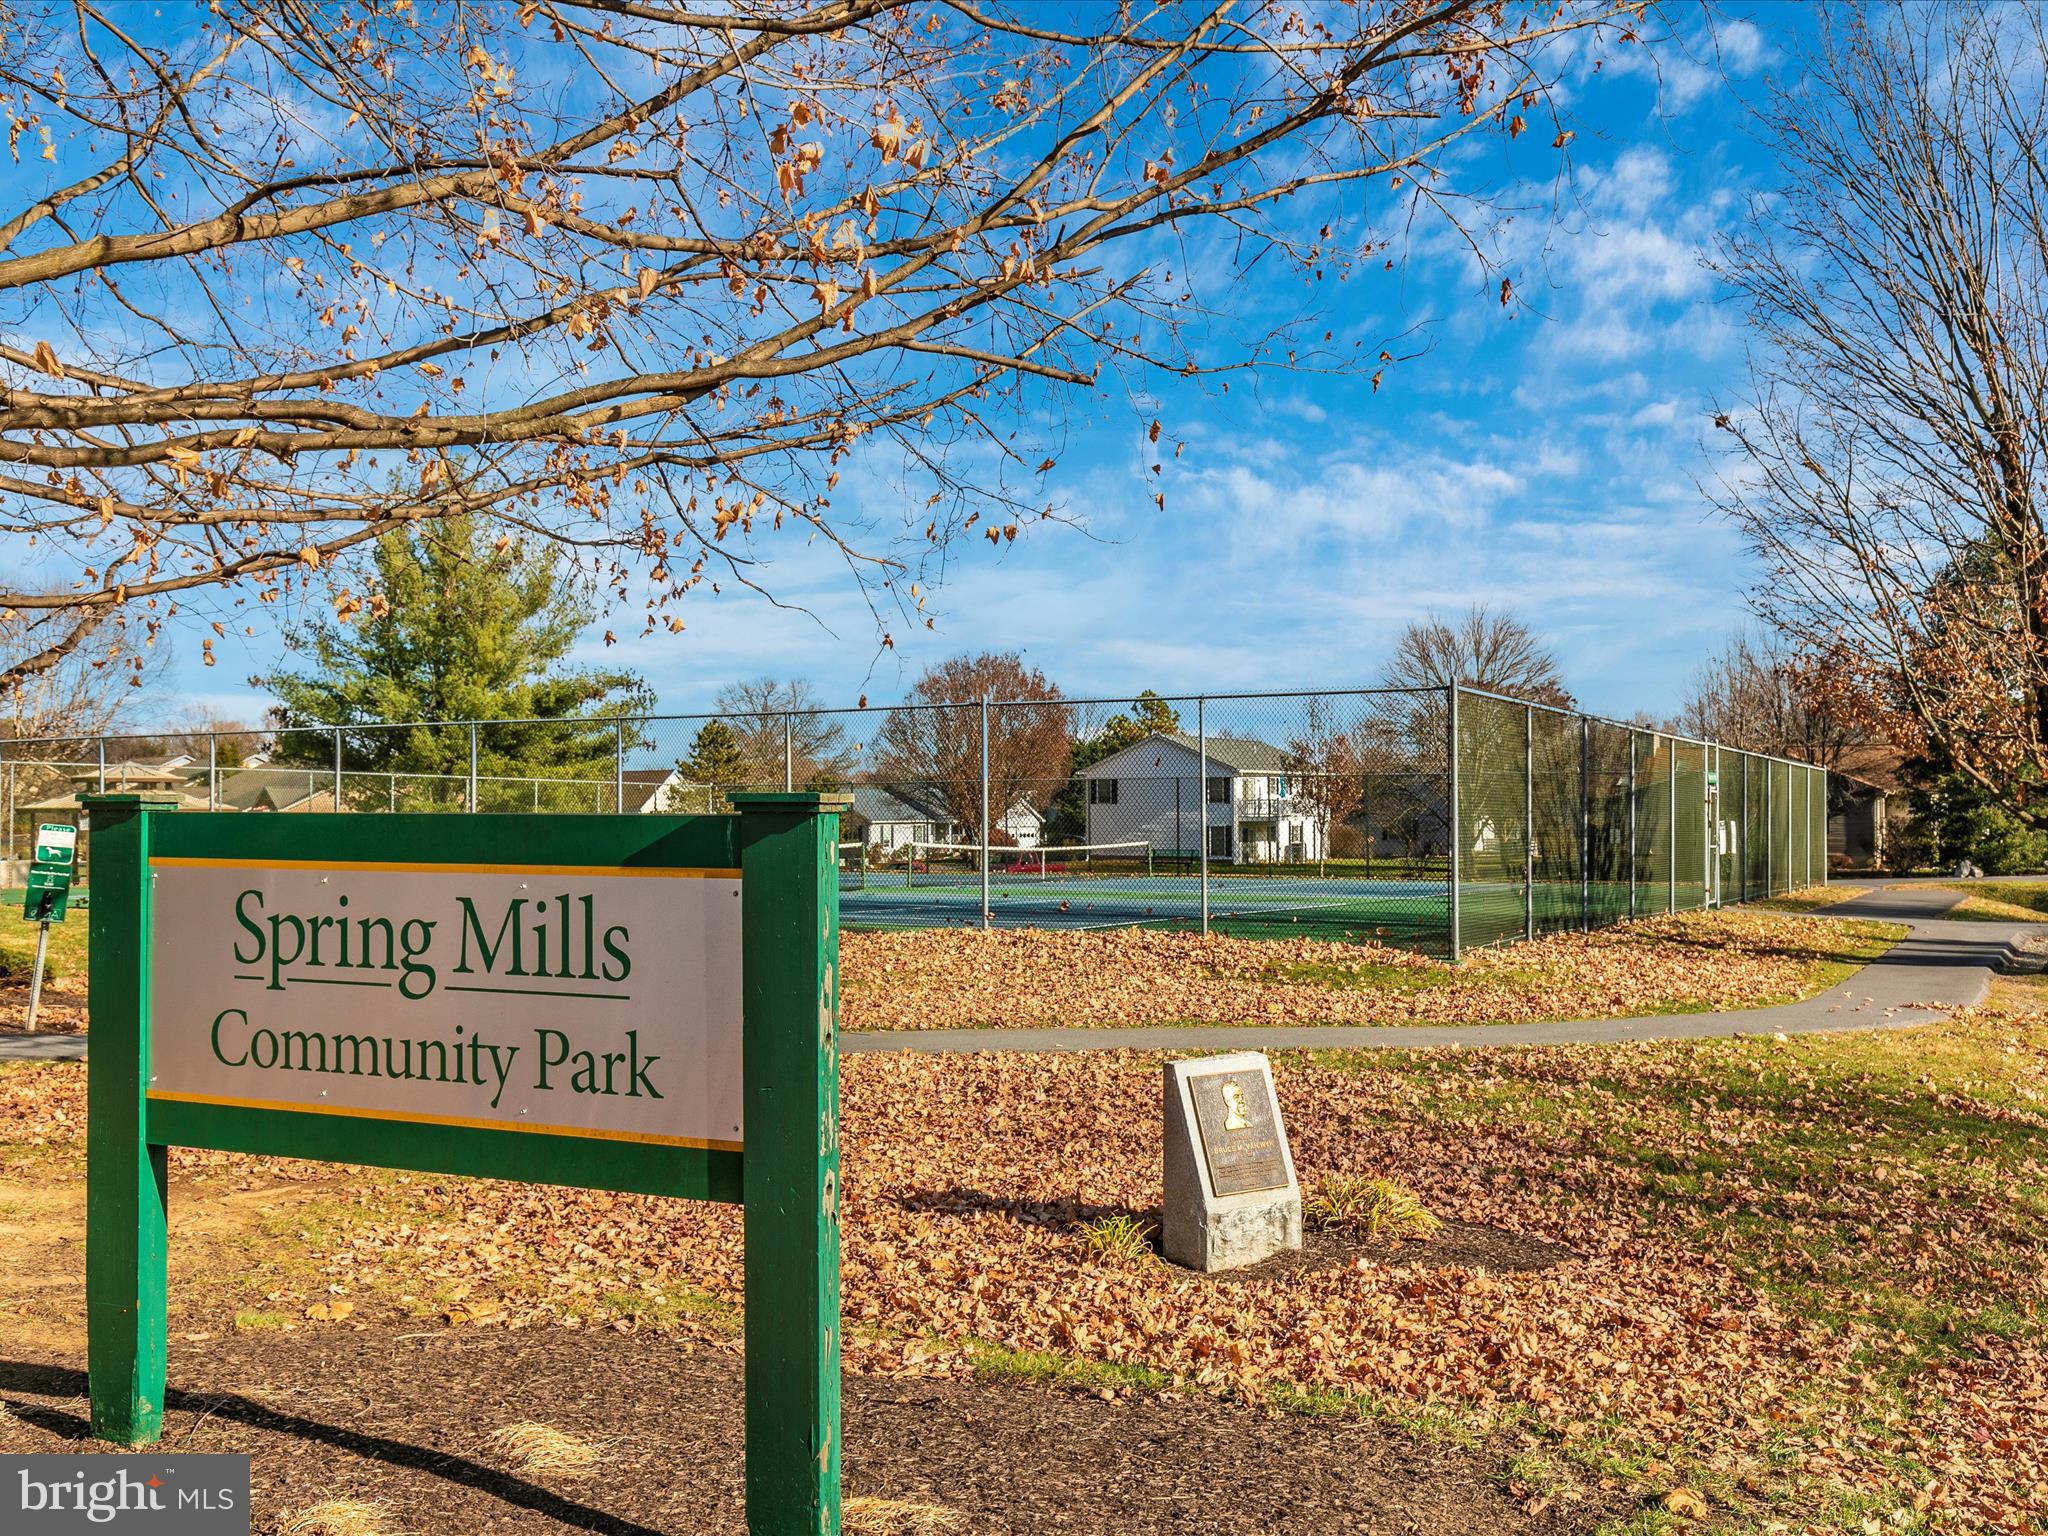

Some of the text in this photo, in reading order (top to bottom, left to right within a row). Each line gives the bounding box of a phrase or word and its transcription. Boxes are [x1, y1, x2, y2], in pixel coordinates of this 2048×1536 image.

[233, 889, 631, 1000] Spring Mills
[210, 1008, 664, 1109] Community Park
